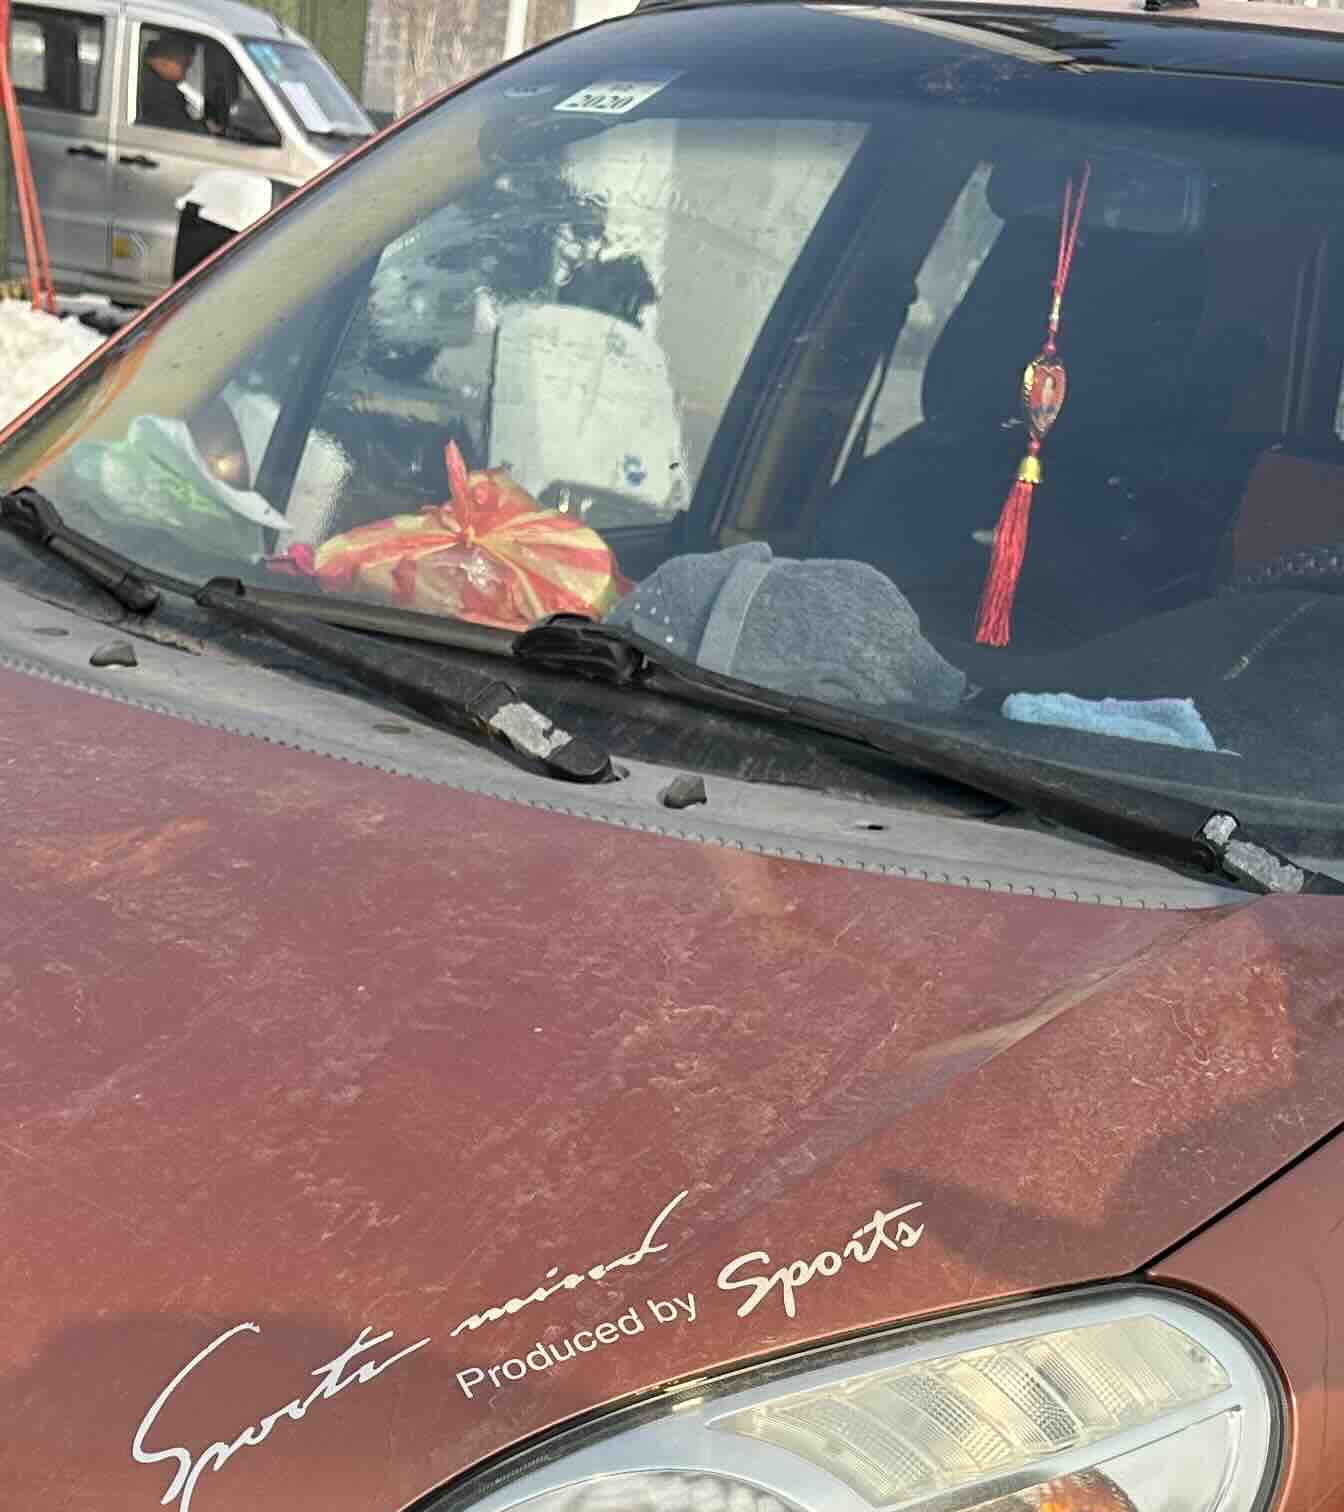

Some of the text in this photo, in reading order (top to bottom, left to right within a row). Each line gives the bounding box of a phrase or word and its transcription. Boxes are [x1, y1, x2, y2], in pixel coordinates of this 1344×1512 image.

[455, 1200, 925, 1400] Produced by Sports
